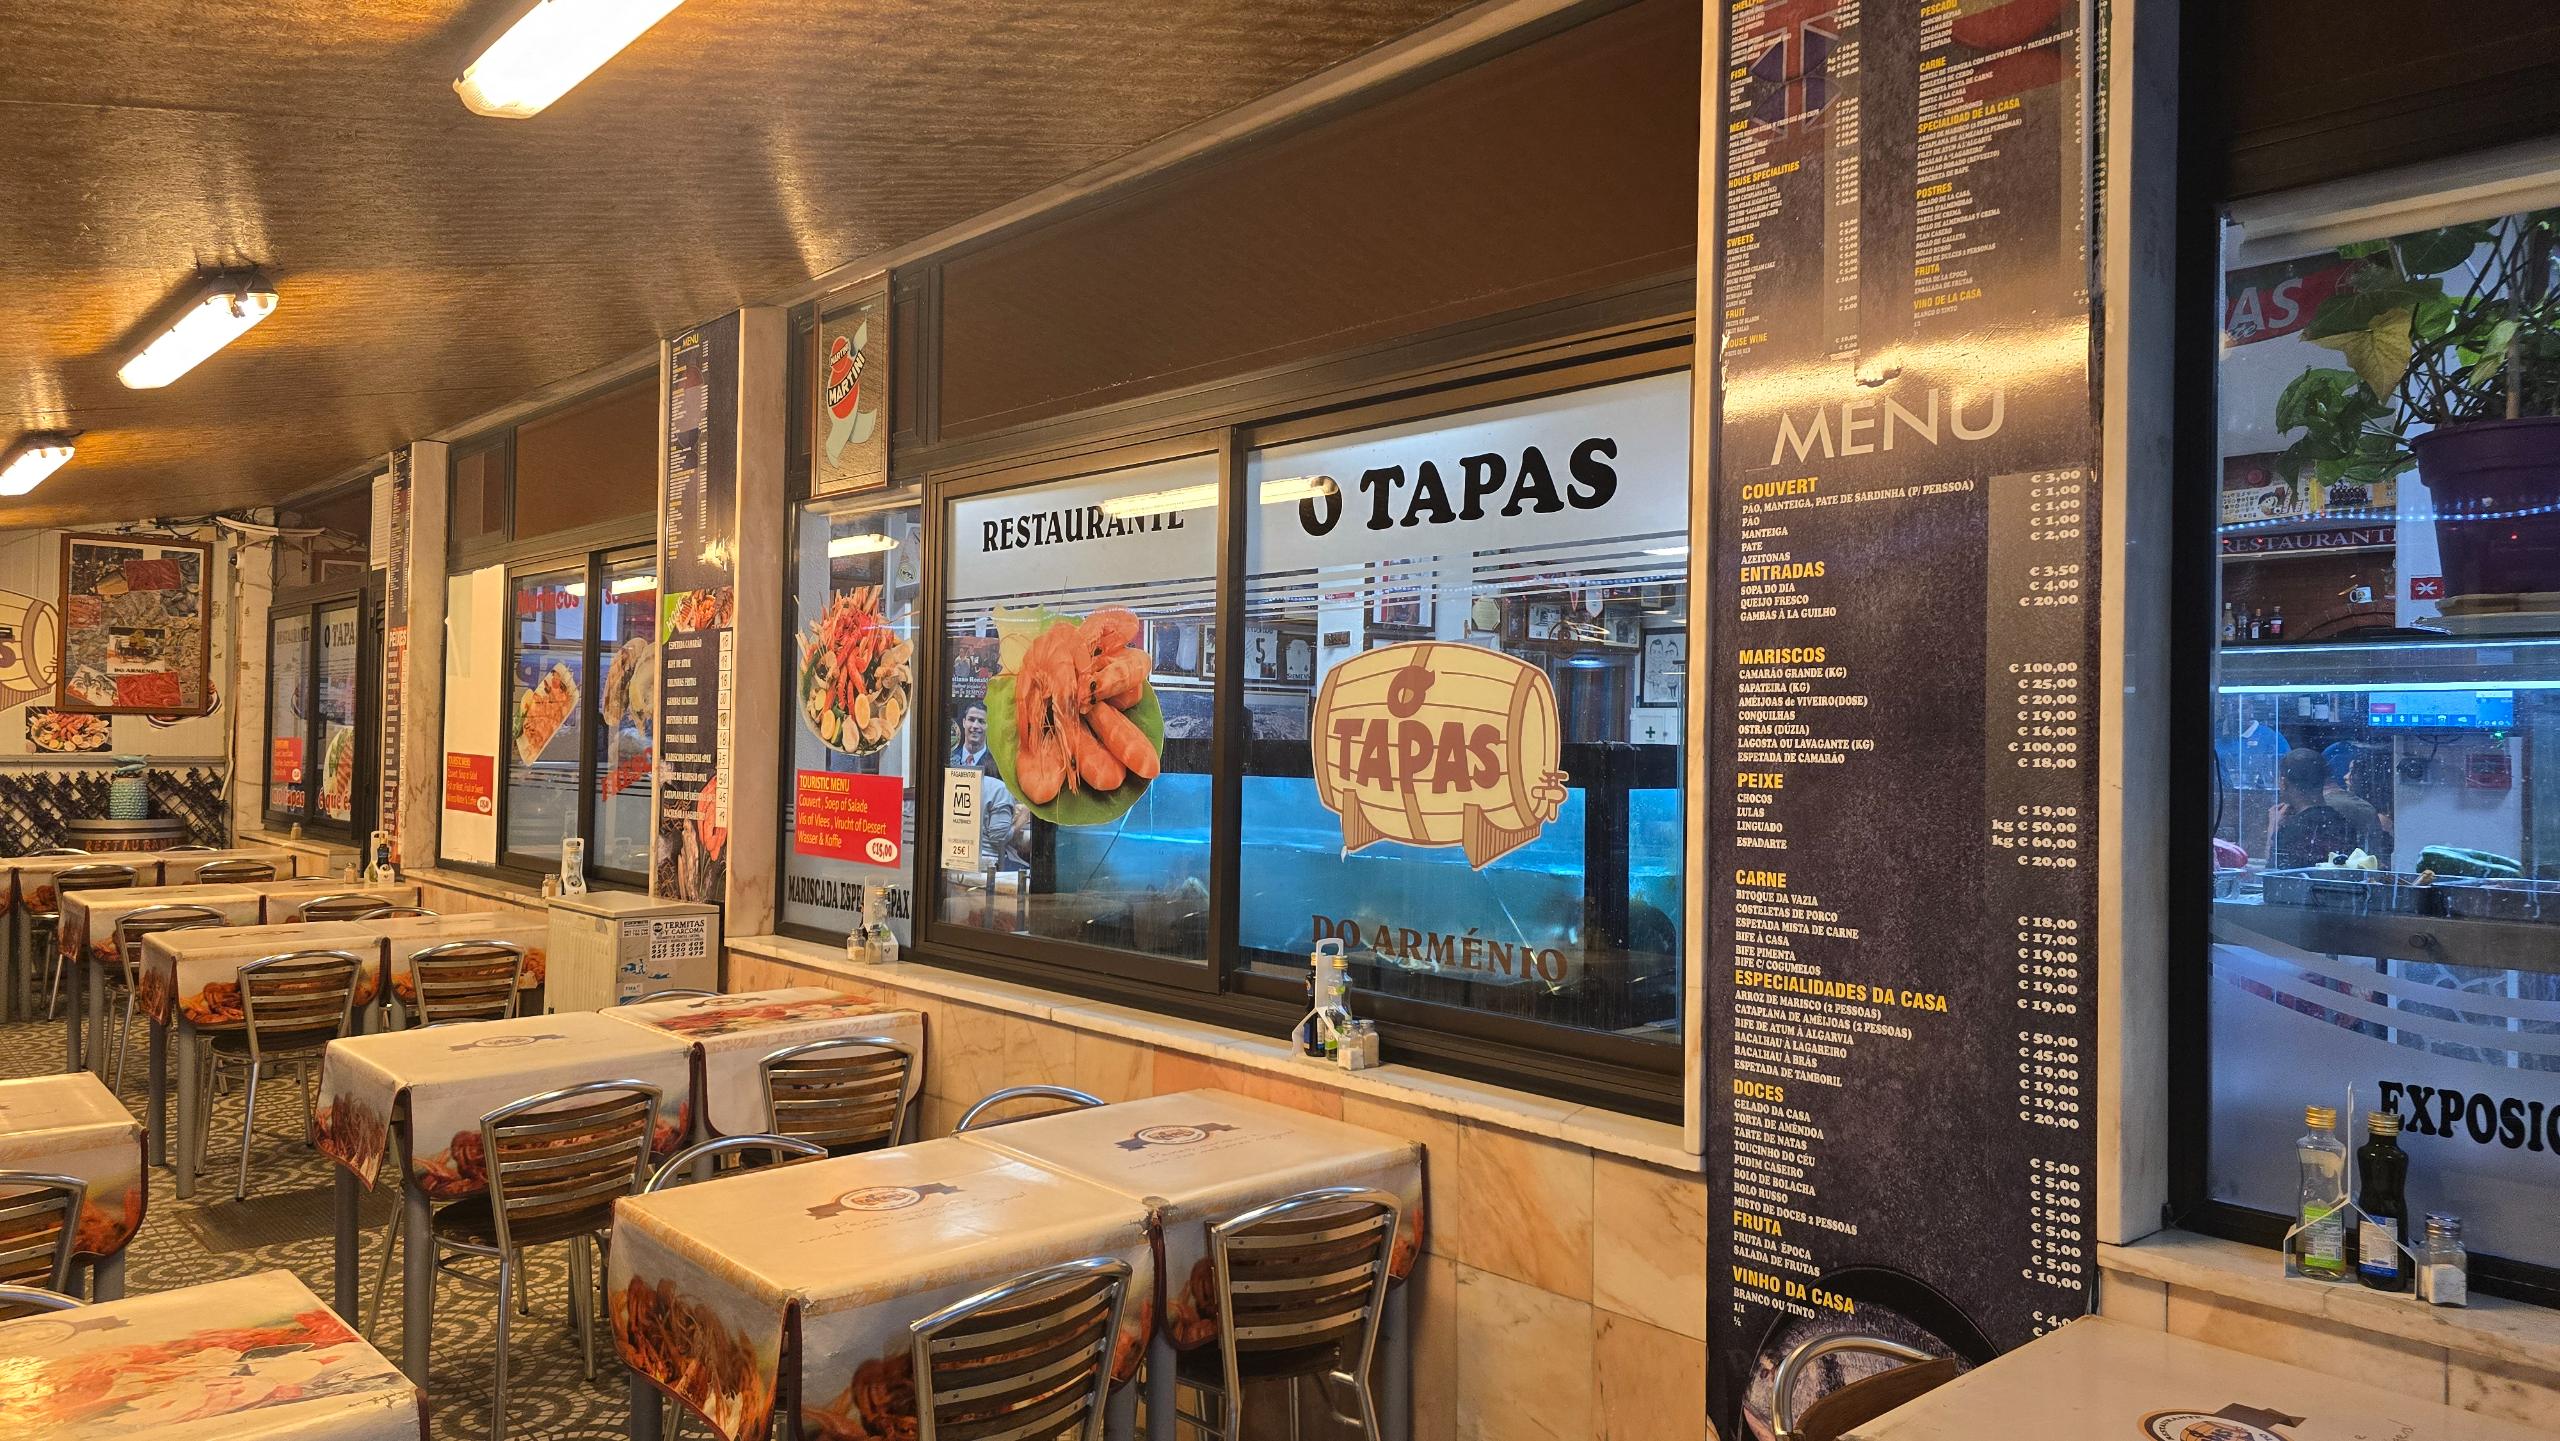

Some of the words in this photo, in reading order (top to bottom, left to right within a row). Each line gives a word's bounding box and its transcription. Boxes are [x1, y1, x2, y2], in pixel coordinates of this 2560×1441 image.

[1921, 0, 1958, 16] PESCADO
[1919, 56, 1946, 71] CARNE
[1730, 67, 1747, 80] FISH
[1918, 111, 1970, 132] SPECIALIDAD
[1972, 107, 1983, 119] DE
[1985, 104, 1996, 116] LA
[1997, 98, 2020, 112] CASA
[1729, 120, 1748, 133] MEAT
[1728, 170, 1751, 187] HOUSE
[1752, 161, 1800, 182] SPECIALITIES
[1916, 182, 1953, 198] POSTRES
[1727, 233, 1754, 247] SWEETS
[1914, 263, 1940, 278] FRUTA
[1913, 298, 1932, 313] VINO
[1935, 295, 1945, 306] DE
[1947, 293, 1957, 304] LA
[1959, 288, 1982, 300] CASA
[1726, 307, 1746, 320] FRUIT
[1749, 332, 1767, 343] WINE
[829, 350, 866, 406] MARTINI
[1771, 388, 2006, 466] MENU
[2044, 470, 2080, 482] 3,00
[1299, 475, 1342, 536] O
[1360, 438, 1617, 530] TAPAS
[1742, 477, 1818, 499] COUVERT
[1741, 515, 1760, 526] PÃO
[1741, 526, 1788, 539] MANTEIGA
[1741, 541, 1762, 551] PATE
[1740, 552, 1790, 564] AZEITONAS
[1740, 561, 1824, 581] ENTRADAS
[1740, 585, 1763, 595] SOPA
[1764, 583, 1777, 593] DO
[1778, 582, 1795, 592] DIA
[1740, 597, 1772, 609] QUEIJO
[1773, 594, 1809, 605] FRESCO
[1255, 638, 1266, 664] 5
[1739, 647, 1825, 664] MARISCOS
[2022, 662, 2077, 673] 100,00
[1738, 682, 1787, 692] SAPATEIRA
[1788, 682, 1810, 693] (KG)
[1738, 710, 1795, 722] CONQUILHAS
[1737, 724, 1772, 734] OSTRAS
[1773, 723, 1809, 735] (DÚZIA)
[1333, 719, 1500, 794] TAPAS
[800, 775, 829, 790] TOURISTIC
[830, 778, 850, 792] MENU
[1737, 772, 1783, 788] PEIXE
[825, 797, 839, 813] Soep
[840, 797, 847, 810] of
[847, 798, 868, 813] Salade
[953, 792, 971, 809] MB
[1737, 793, 1772, 804] CHOCOS
[1736, 807, 1764, 817] LULAS
[834, 816, 854, 831] Vrucht
[855, 818, 862, 832] of
[862, 820, 886, 835] Dessert
[1736, 820, 1782, 832] LINGUADO
[1991, 819, 2013, 832] kg
[2031, 821, 2076, 833] 50,00
[953, 846, 966, 855] 25€
[1736, 837, 1787, 849] ESPADARTE
[1735, 870, 1786, 887] CARNE
[788, 876, 838, 909] MARISCADA
[1735, 889, 1774, 902] BITOQUE
[1775, 892, 1789, 903] DA
[1790, 894, 1818, 906] VAZIA
[1735, 903, 1790, 917] COSTELETAS
[1791, 908, 1804, 919] DE
[1805, 910, 1838, 922] PORCO
[664, 920, 705, 929] TERMITAS
[671, 927, 704, 935] CARCOMA
[2032, 917, 2077, 930] 18,00
[1312, 914, 1361, 949] DO
[1373, 927, 1568, 982] ARMÉNIO
[1735, 944, 1755, 959] BIFE
[1756, 947, 1796, 960] PIMENTA
[1735, 970, 1866, 1001] ESPECIALIDADES
[1872, 987, 1895, 1005] DA
[1900, 991, 1947, 1011] CASA
[1734, 1045, 1782, 1061] BACALHAU
[1783, 1052, 1791, 1063] À
[1792, 1054, 1817, 1067] BRÁS
[1733, 1079, 1783, 1102] DOCES
[1733, 1098, 1769, 1113] GELADO
[1771, 1105, 1784, 1117] DA
[1785, 1108, 1811, 1122] CASA
[1734, 1154, 1762, 1169] PUDIM
[1763, 1161, 1803, 1178] CASEIRO
[1734, 1210, 1782, 1236] FRUTA
[1733, 1245, 1768, 1262] SALADA
[1770, 1254, 1782, 1266] DE
[1784, 1258, 1820, 1276] FRUTAS
[1732, 1266, 1780, 1292] VINHO
[1785, 1280, 1806, 1300] DA
[1811, 1288, 1854, 1313] CASA
[1733, 1287, 1770, 1305] BRANCO
[1771, 1298, 1785, 1310] OU
[1786, 1302, 1814, 1319] TINTO
